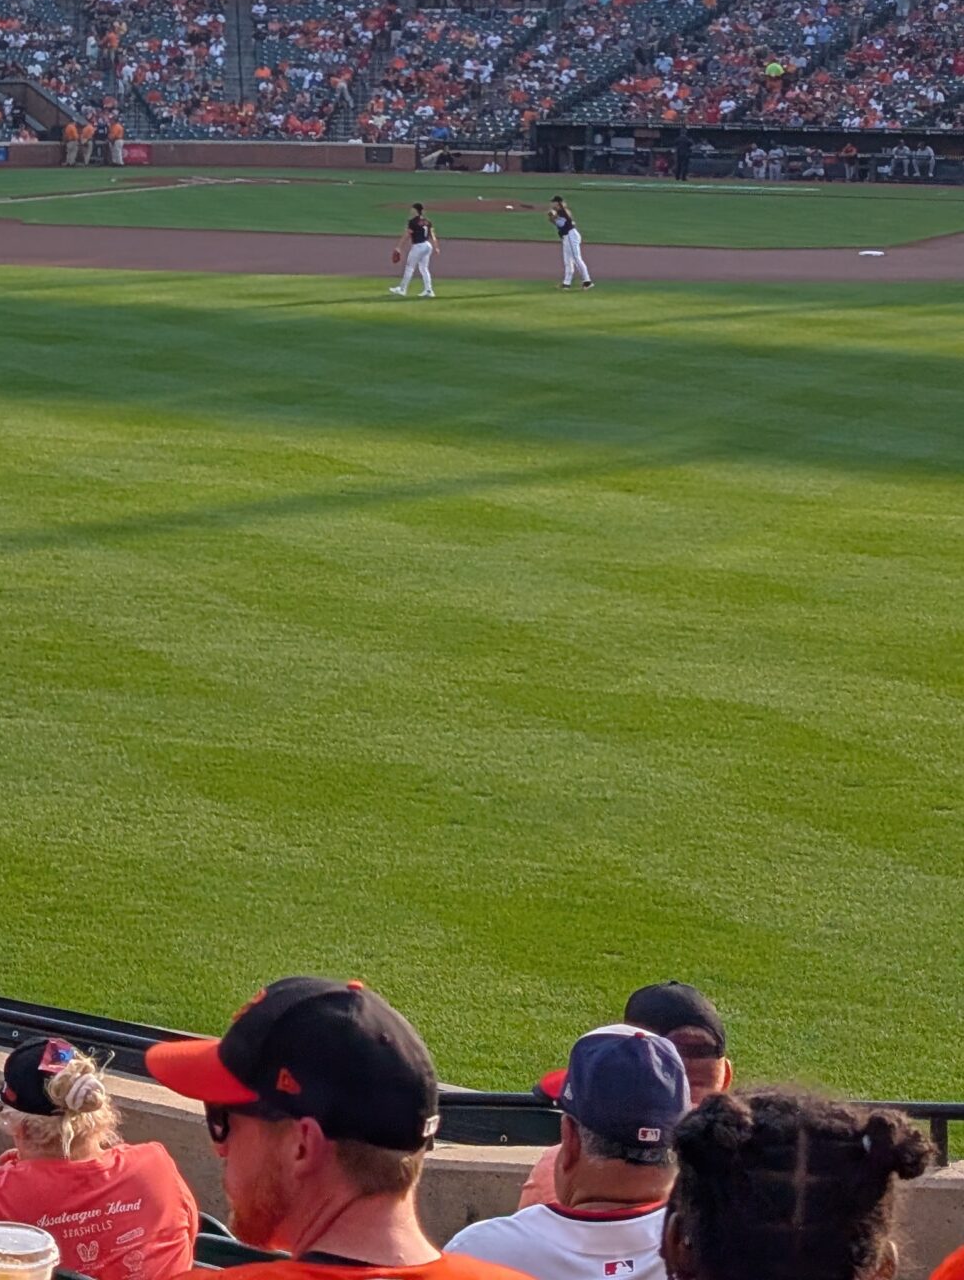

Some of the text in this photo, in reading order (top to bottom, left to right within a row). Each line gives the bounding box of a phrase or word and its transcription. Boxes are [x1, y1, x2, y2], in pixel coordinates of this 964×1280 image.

[36, 1198, 142, 1228] Assateague Island
[62, 1220, 113, 1239] SEASHELLS
